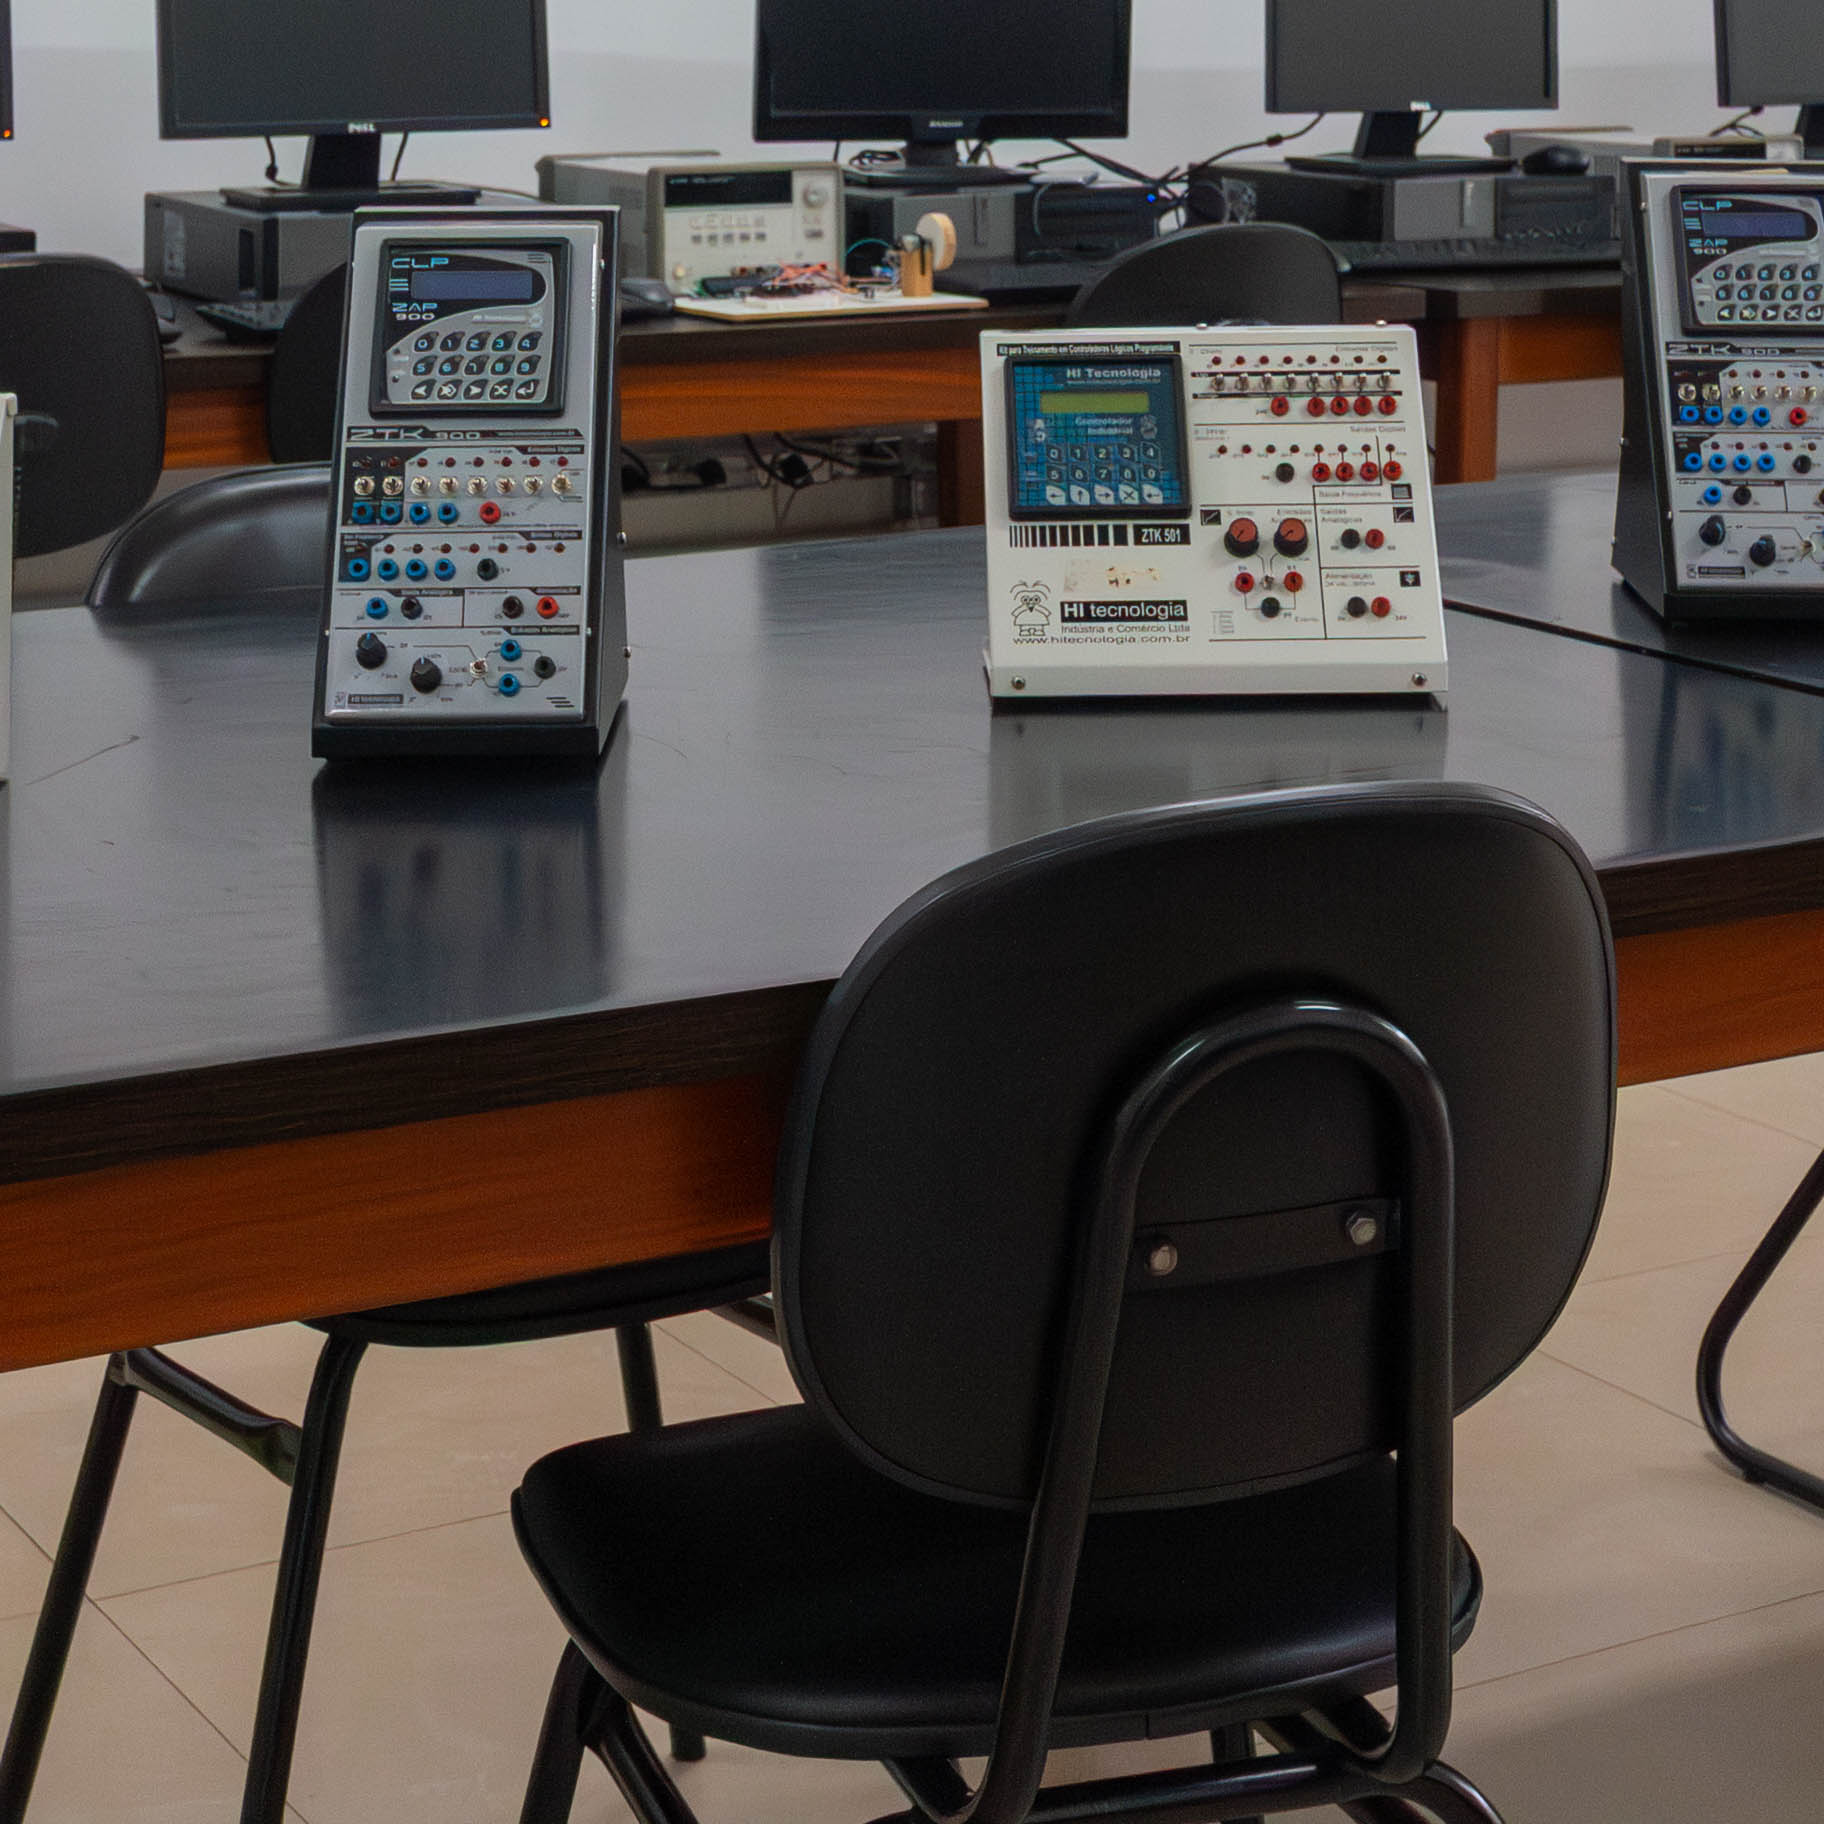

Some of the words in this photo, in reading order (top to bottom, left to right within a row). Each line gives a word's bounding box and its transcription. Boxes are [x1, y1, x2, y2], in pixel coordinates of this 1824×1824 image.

[1682, 200, 1733, 211] CLP
[391, 257, 449, 269] CLP
[391, 302, 438, 312] ZAP
[395, 312, 436, 321] 900
[350, 428, 424, 440] ZTK
[1141, 528, 1162, 543] ZTK
[1164, 528, 1181, 543] 501
[1064, 603, 1084, 618] HI
[1090, 602, 1185, 620] tecnologia
